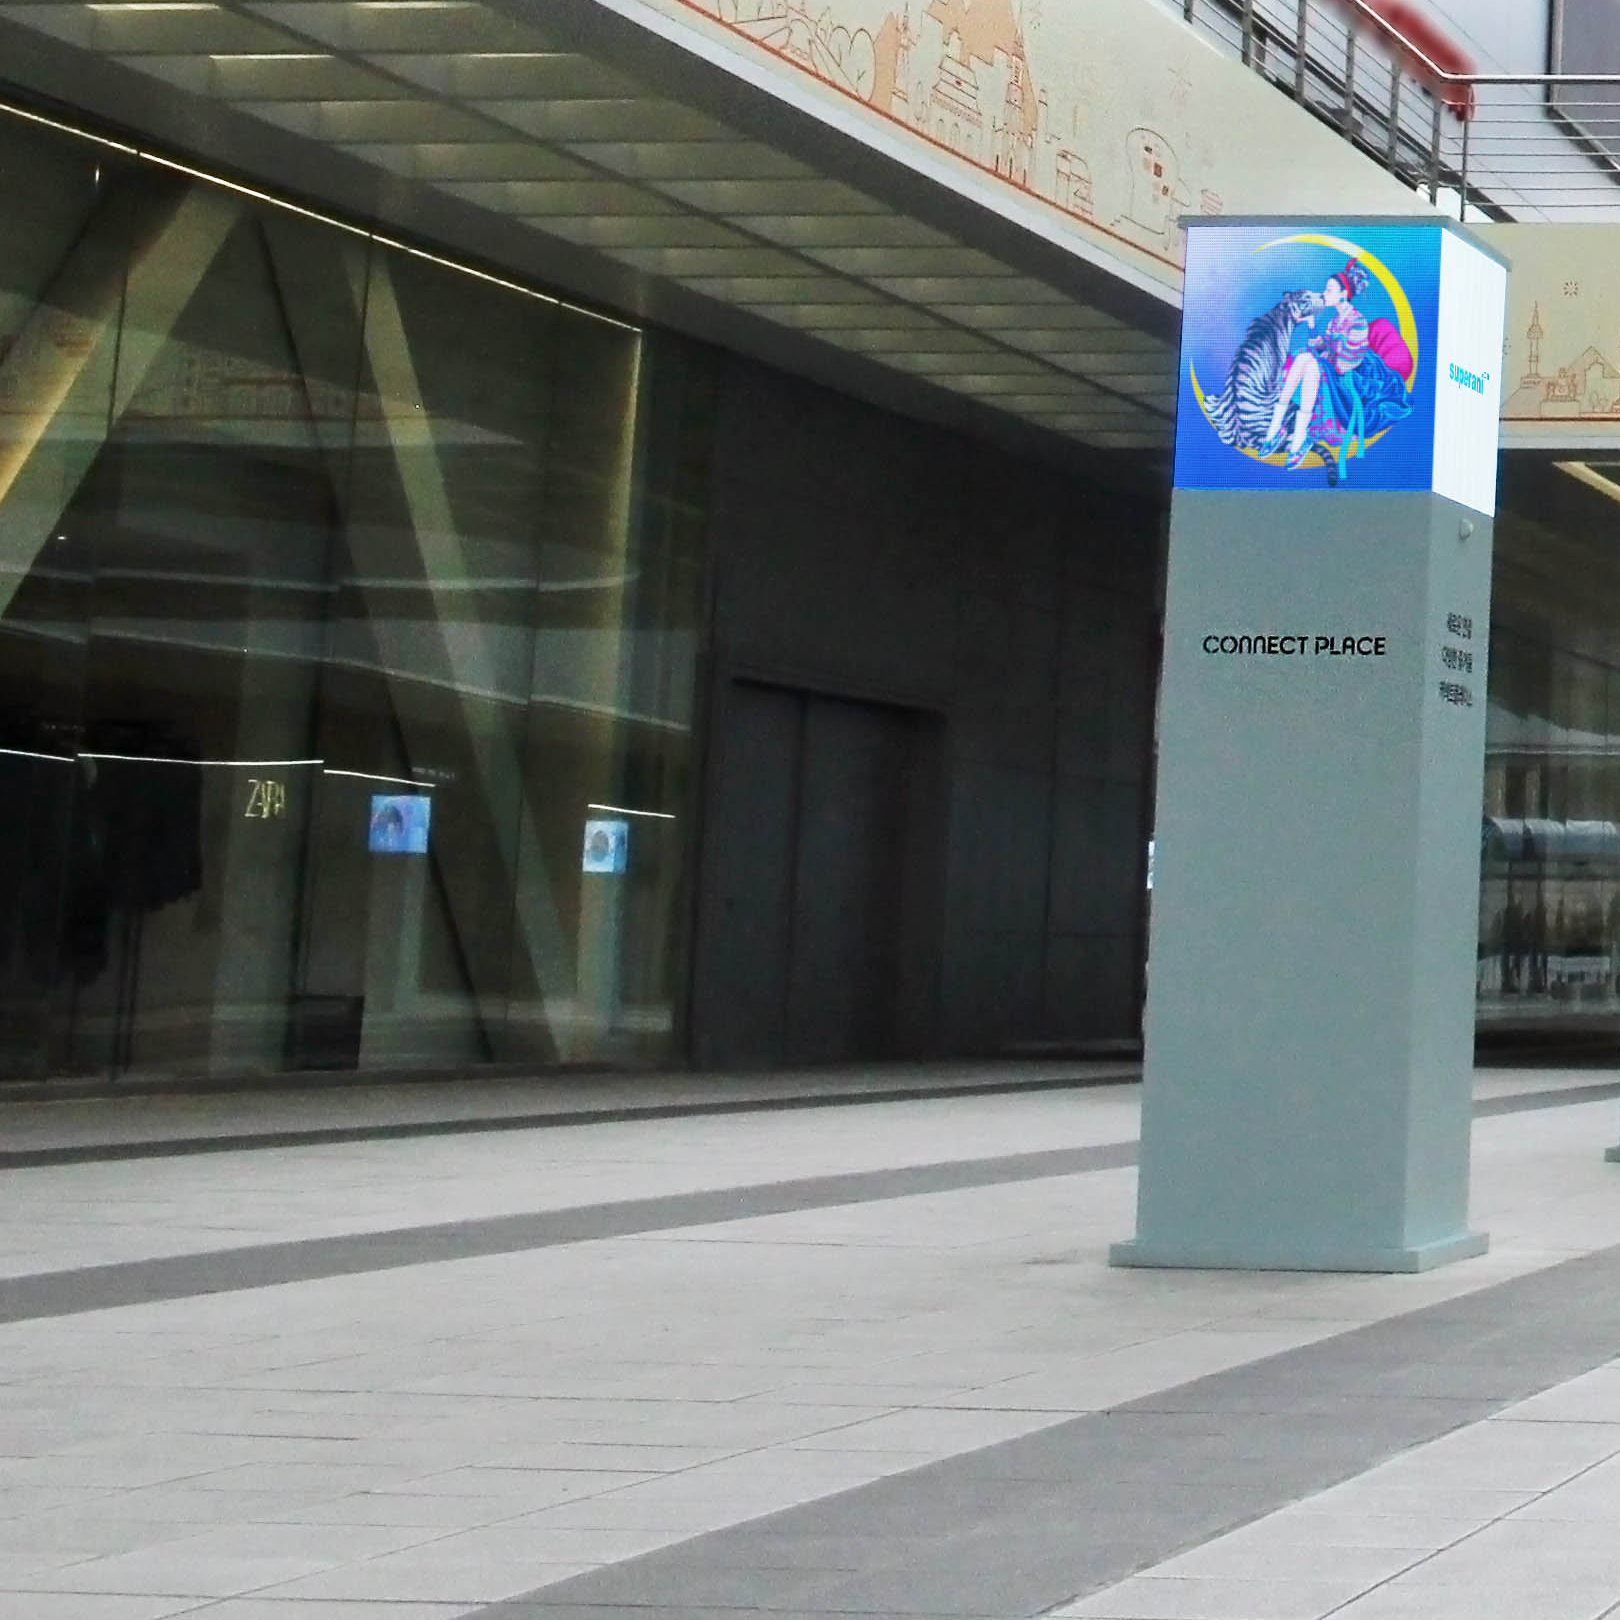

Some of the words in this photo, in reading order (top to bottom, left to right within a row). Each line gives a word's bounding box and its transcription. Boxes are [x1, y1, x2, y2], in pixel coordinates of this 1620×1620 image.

[1449, 363, 1484, 396] superani
[1203, 636, 1309, 656] CONNECT
[1314, 636, 1386, 656] PLACE
